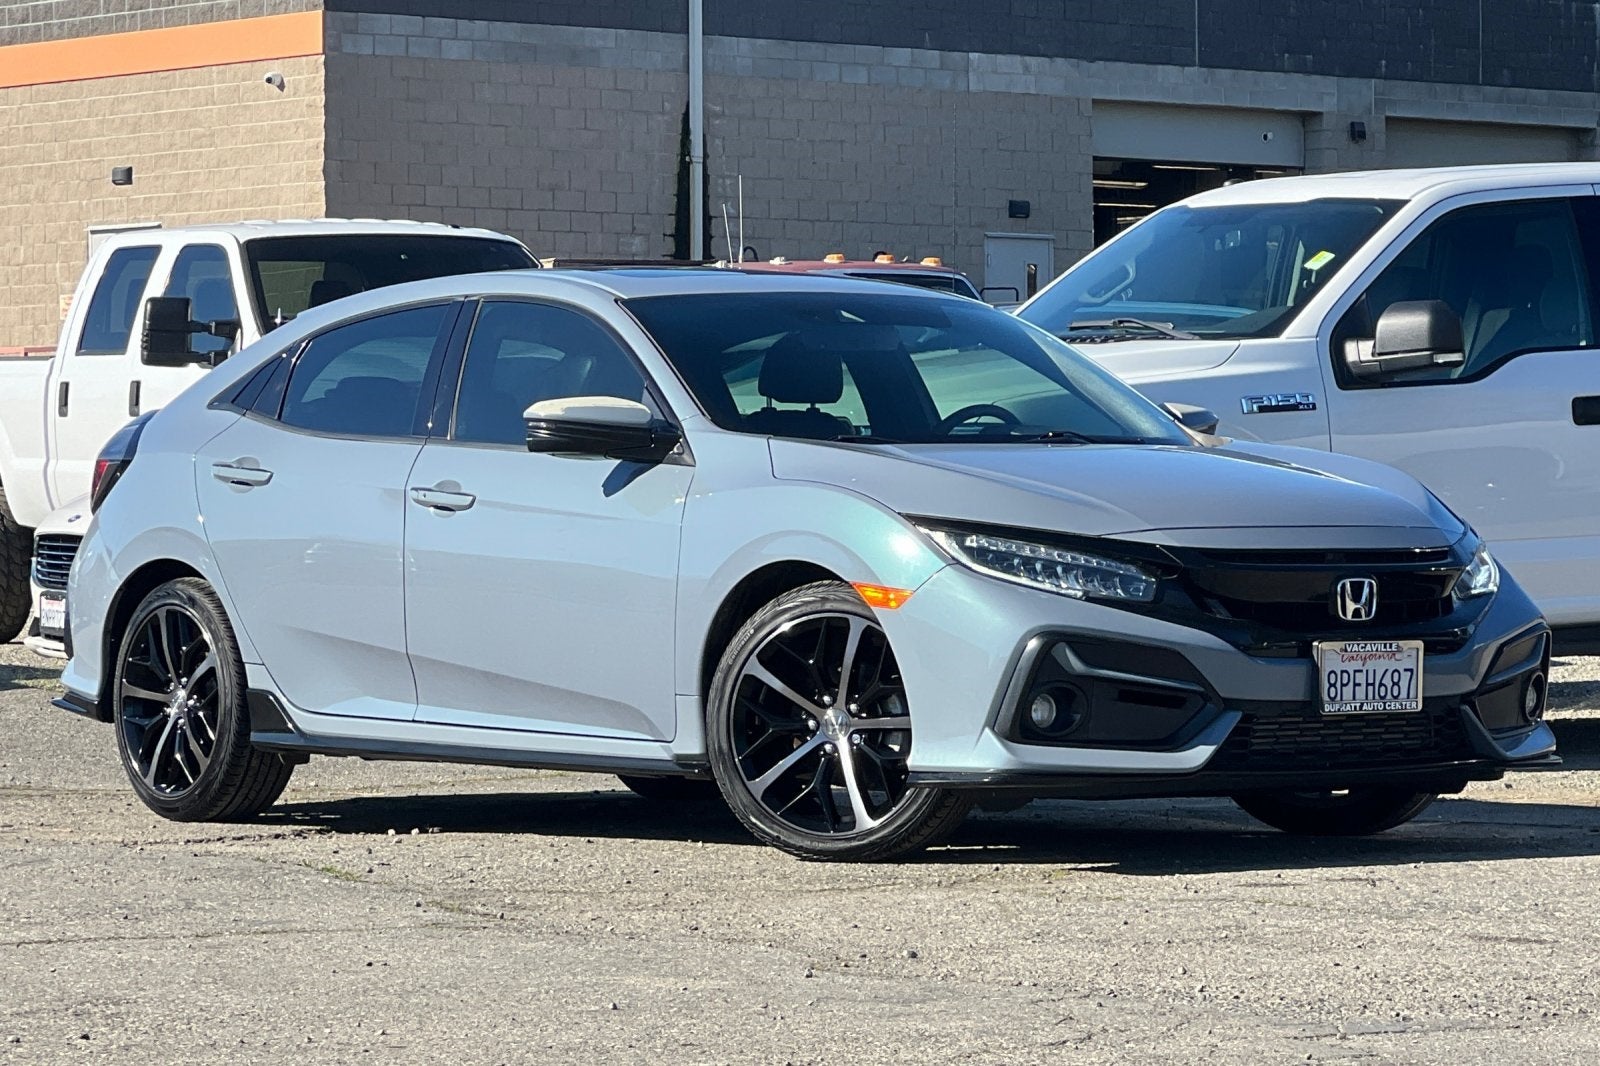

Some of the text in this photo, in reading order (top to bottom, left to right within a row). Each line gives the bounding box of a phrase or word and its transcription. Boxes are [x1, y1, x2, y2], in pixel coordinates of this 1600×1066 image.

[1346, 643, 1398, 652] VACAVILLE
[1327, 668, 1414, 701] 8PFH687
[1362, 702, 1384, 711] AUTO
[1385, 701, 1417, 710] CENTER
